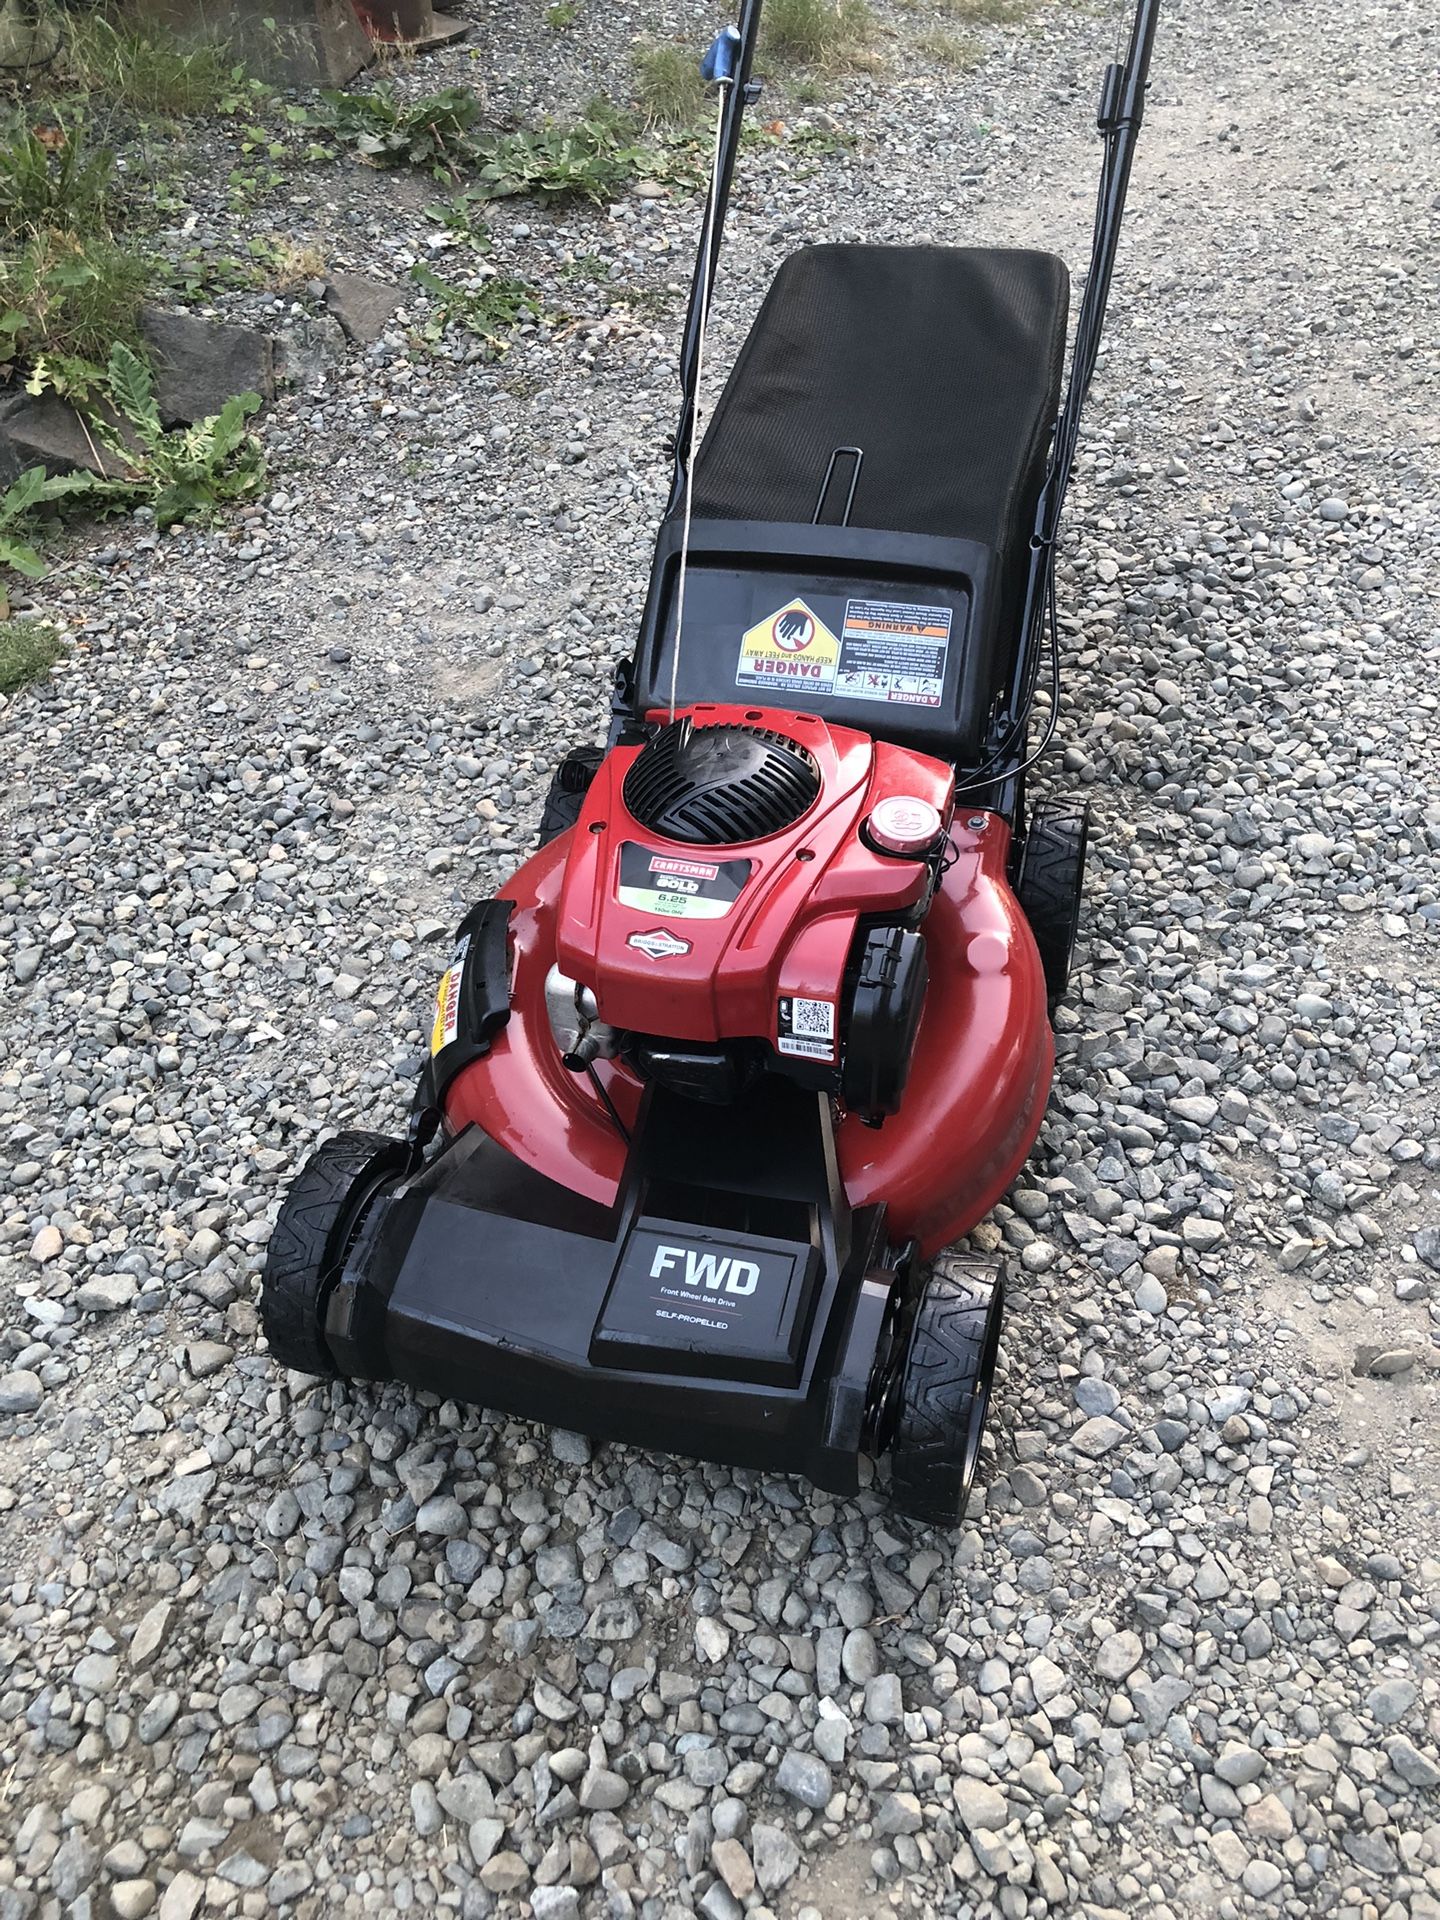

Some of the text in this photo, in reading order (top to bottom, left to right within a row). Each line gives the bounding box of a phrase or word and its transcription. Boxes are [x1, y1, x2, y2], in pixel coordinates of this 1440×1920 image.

[868, 622, 913, 632] WARNING
[765, 651, 780, 659] FEET
[793, 654, 815, 662] HANDS
[754, 659, 821, 678] DANGER
[891, 692, 928, 703] DANGER
[654, 860, 713, 876] CRAFTSMAN
[656, 878, 699, 892] GOLD
[658, 893, 687, 904] 6.25
[444, 971, 461, 1033] DANGER
[649, 1245, 761, 1296] FWD
[660, 1286, 736, 1308] Front Wheel Belt Drive
[655, 1309, 729, 1330] SELF-PROPELLED
